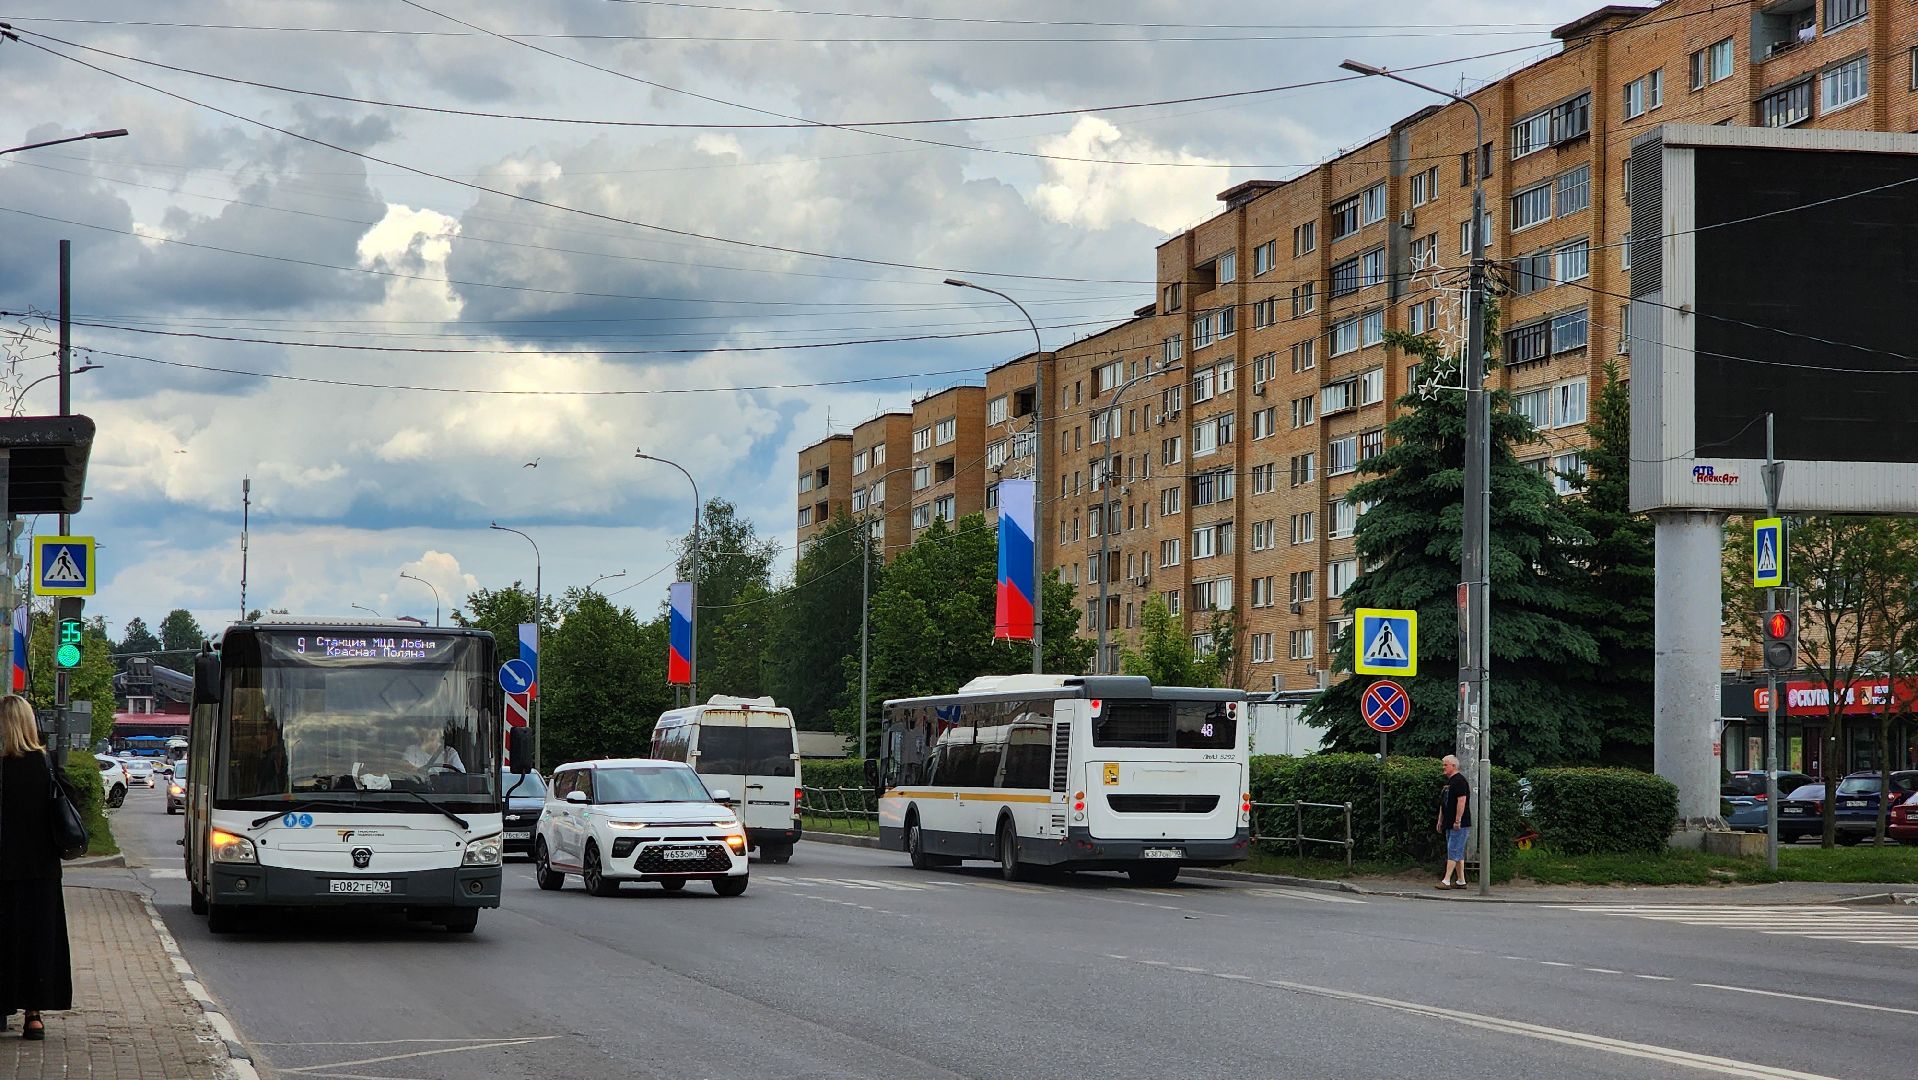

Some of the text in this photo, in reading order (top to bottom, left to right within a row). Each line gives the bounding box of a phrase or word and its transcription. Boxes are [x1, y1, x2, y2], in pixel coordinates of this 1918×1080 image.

[1692, 465, 1714, 476] АТВ
[62, 622, 80, 642] 35
[297, 636, 436, 654] 9 Станция МЦД Лобня
[326, 646, 425, 658] Красная Поляна
[1200, 723, 1214, 737] 48
